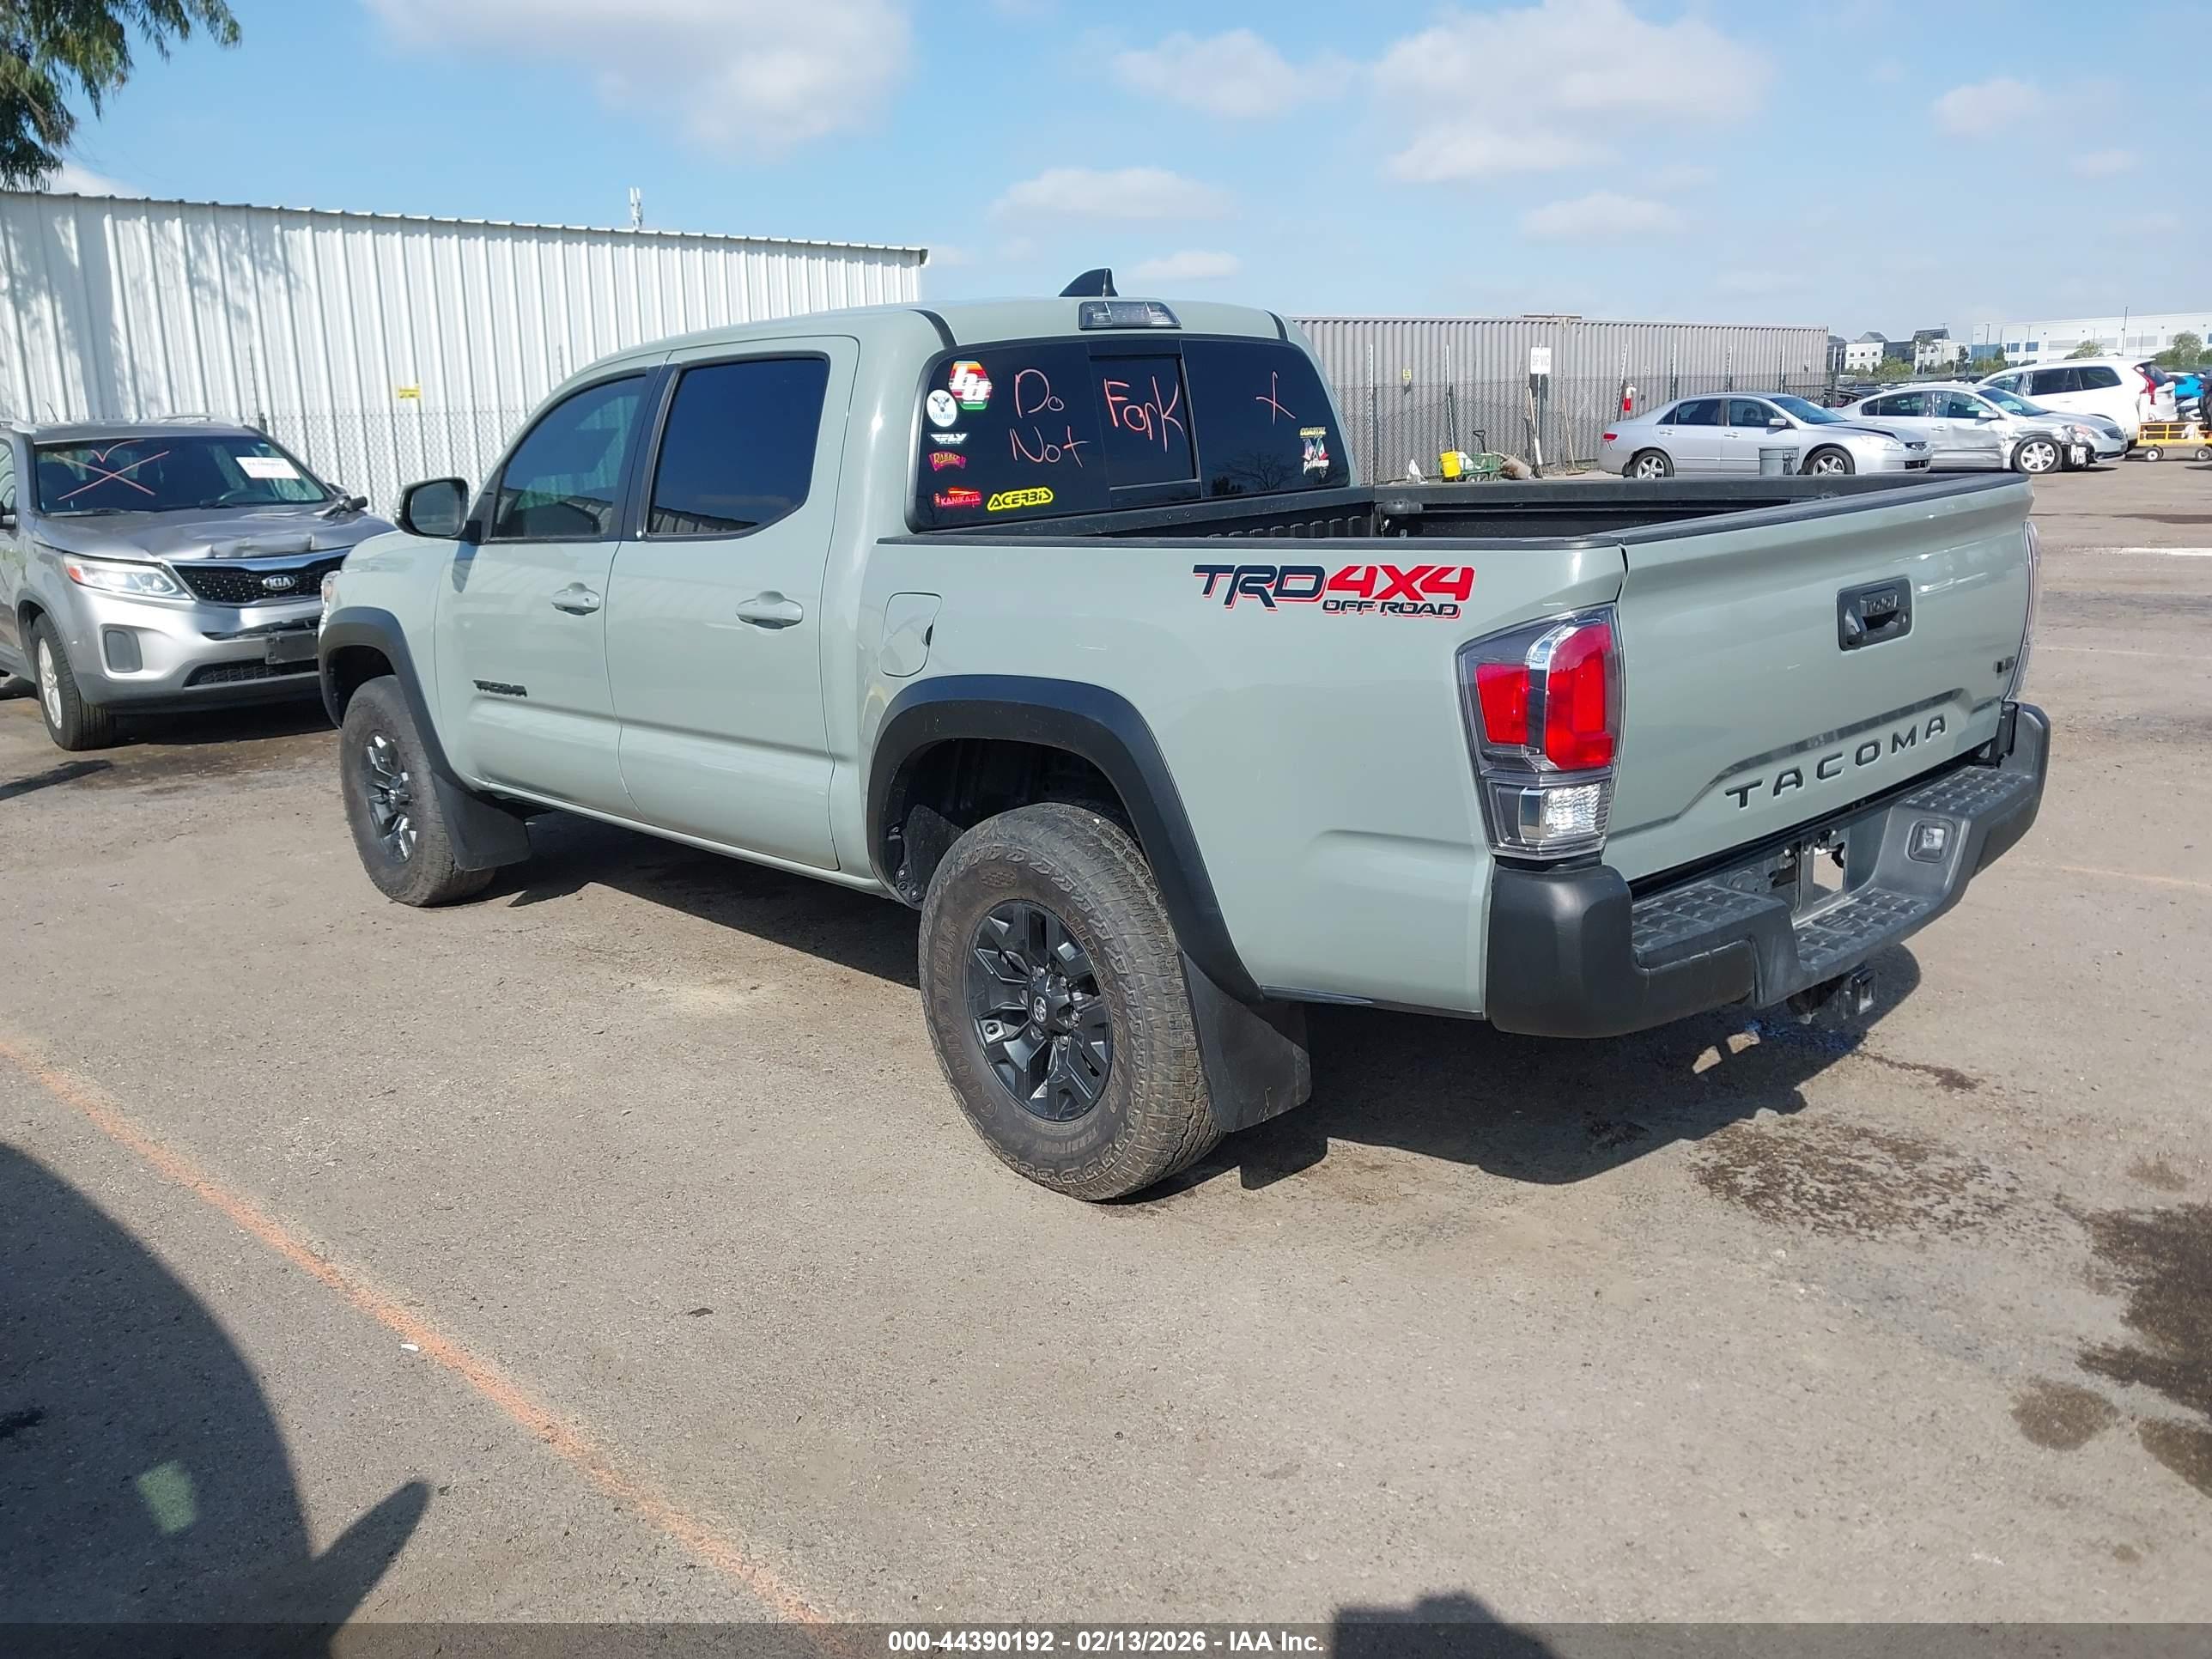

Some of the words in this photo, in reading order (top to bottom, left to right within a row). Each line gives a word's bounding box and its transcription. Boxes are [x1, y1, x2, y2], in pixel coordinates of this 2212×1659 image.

[1015, 368, 1065, 418] Do
[1104, 375, 1188, 453] Fork
[1010, 426, 1091, 468] Not
[989, 490, 1051, 508] ACERBIS
[268, 576, 292, 588] KIA
[1194, 564, 1328, 611] TRD
[1322, 599, 1377, 616] OFF
[1379, 601, 1462, 619] ROAD
[1724, 714, 1948, 810] TACOMA
